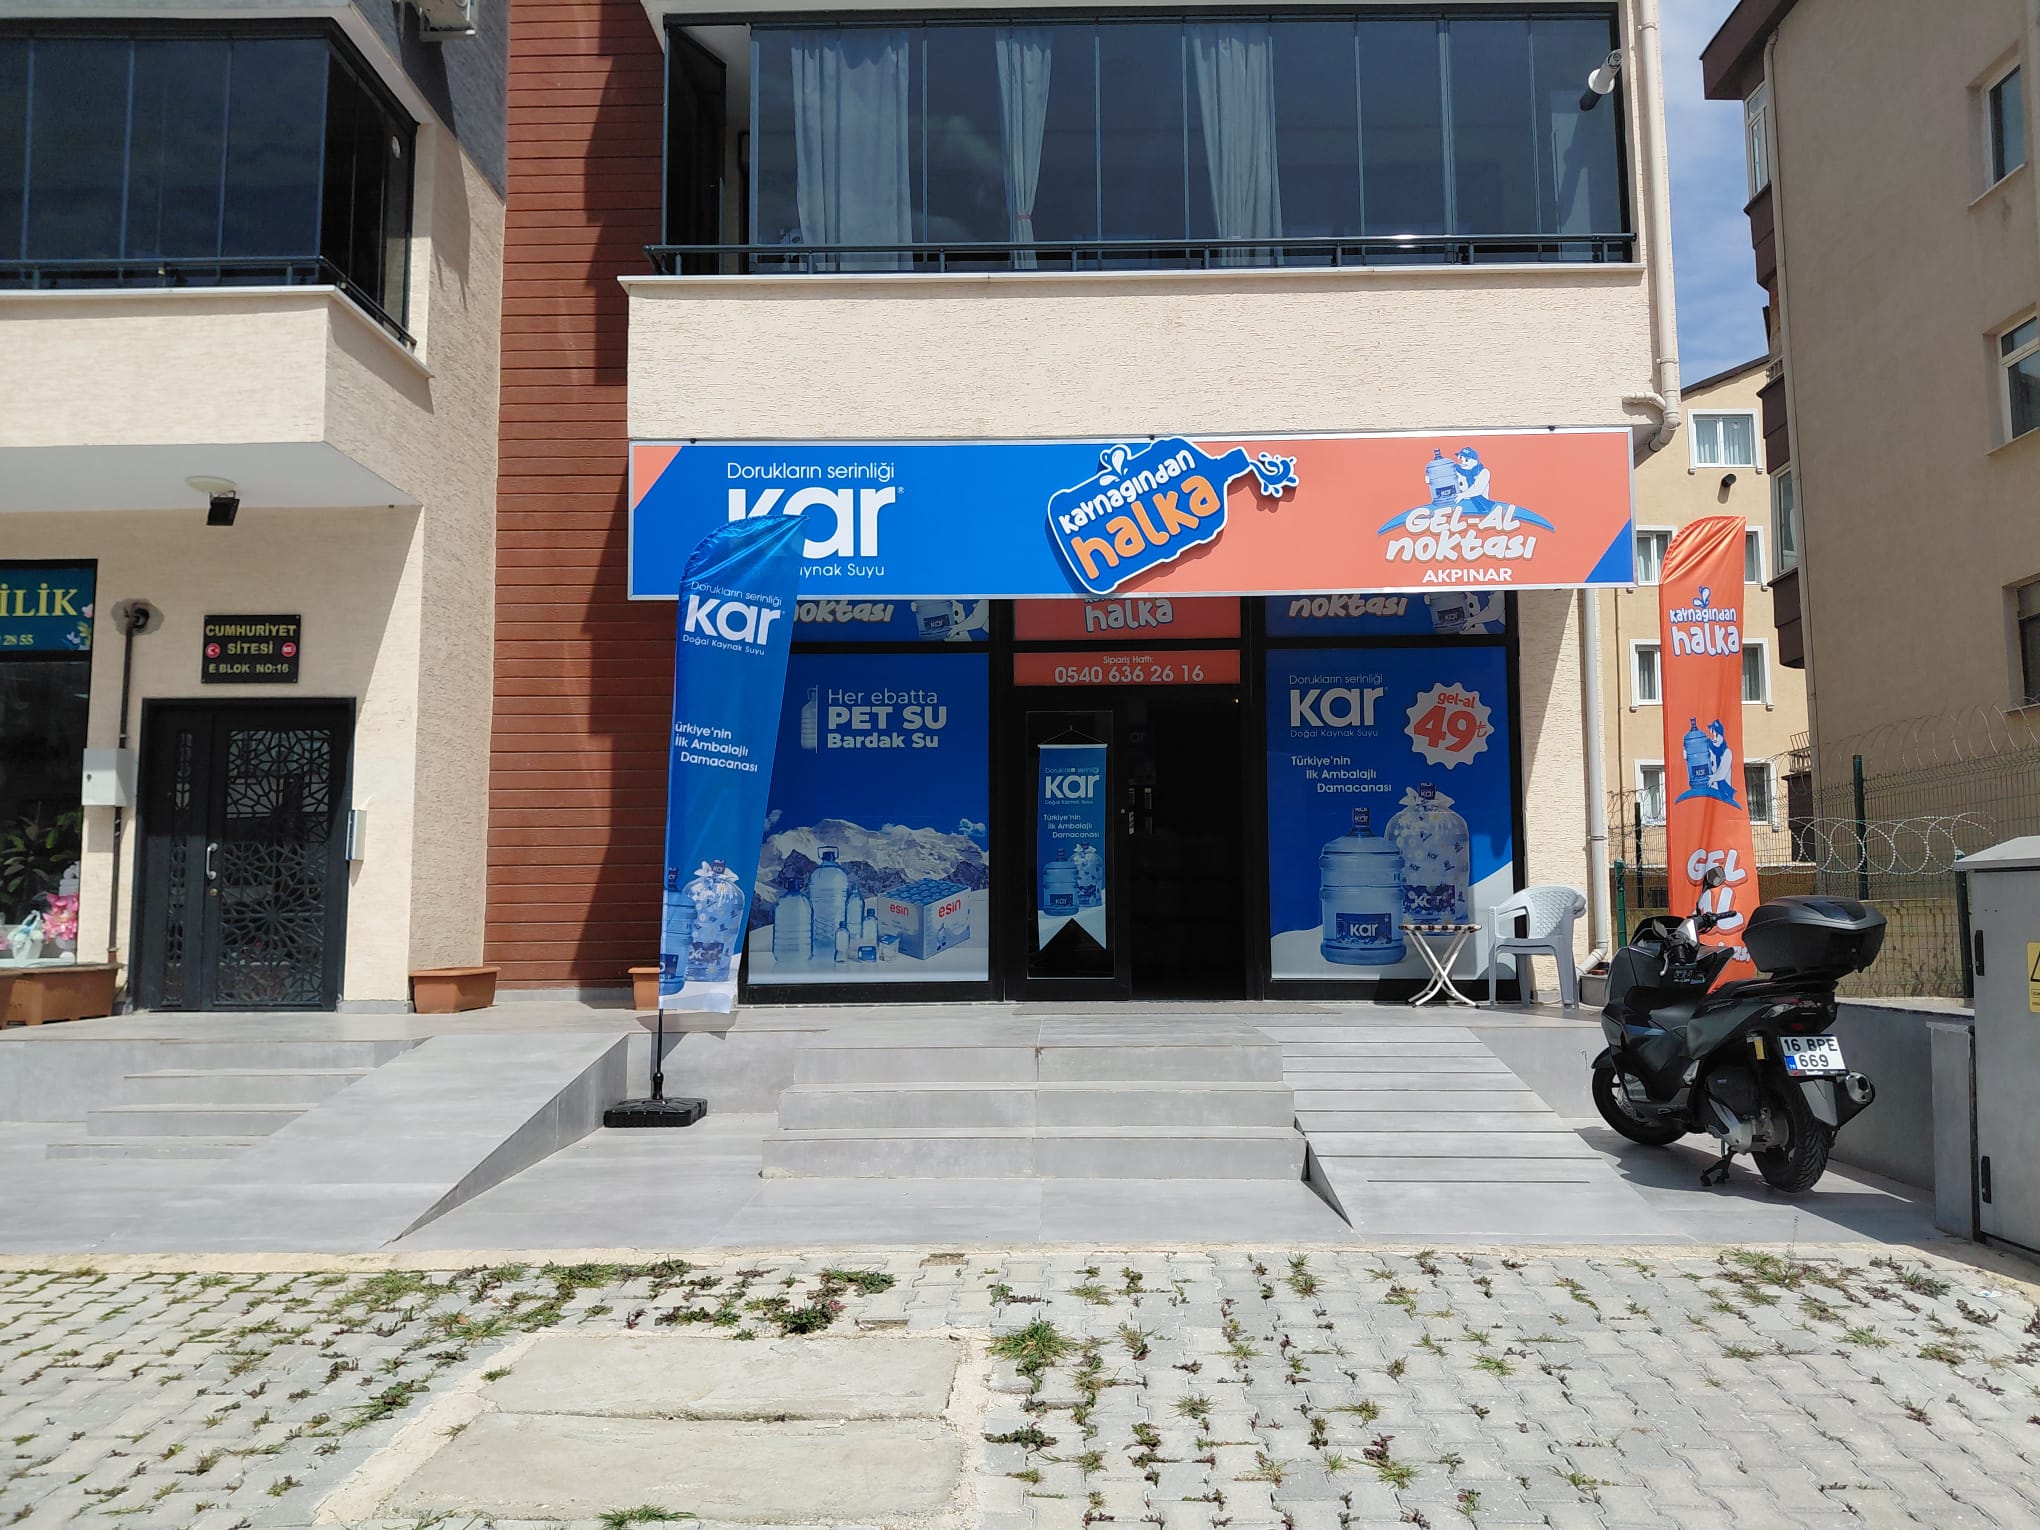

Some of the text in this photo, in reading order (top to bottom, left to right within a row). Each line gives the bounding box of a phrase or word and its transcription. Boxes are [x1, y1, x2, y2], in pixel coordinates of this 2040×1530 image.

[727, 461, 895, 482] Dorukların serinliği
[1071, 475, 1221, 579] halka
[1405, 504, 1521, 533] GEL-AL
[1385, 530, 1537, 561] noktası
[799, 563, 885, 578] ynak Suyu
[1422, 567, 1513, 584] AKPINAR
[690, 580, 782, 608] Dorukların serinliği
[1288, 594, 1408, 618] noktası
[1084, 598, 1174, 632] halka
[205, 622, 297, 637] CUMHURİYET
[227, 640, 274, 655] SİTESİ
[682, 634, 765, 656] Doğal Kaynak Suyu
[1671, 624, 1740, 657] halka
[208, 663, 217, 674] E
[219, 663, 250, 674] BLOK
[1103, 655, 1130, 665] Sipariş
[1054, 664, 1204, 684] 0540 636 26 16
[1289, 673, 1383, 686] Dorukların serinliği
[828, 687, 938, 704] Her ebatta
[1436, 692, 1476, 709] gel-al
[827, 705, 947, 730] PET SU
[674, 721, 732, 740] ürkiye'nin
[1290, 729, 1378, 739] Doğal Kaynak Suyu
[674, 734, 749, 758] İlk Ambalajlı
[827, 732, 939, 748] Bardak Su
[680, 751, 758, 773] Damacanası
[1291, 755, 1351, 767] Türkiye'nin
[1321, 769, 1377, 780] Ambalajlı
[1317, 783, 1392, 793] Damacanası
[1052, 831, 1100, 839] Damacanası
[889, 903, 909, 916] esin
[937, 899, 961, 918] esin
[1783, 1038, 1838, 1052] 16 BPE
[1798, 1054, 1829, 1068] 669
